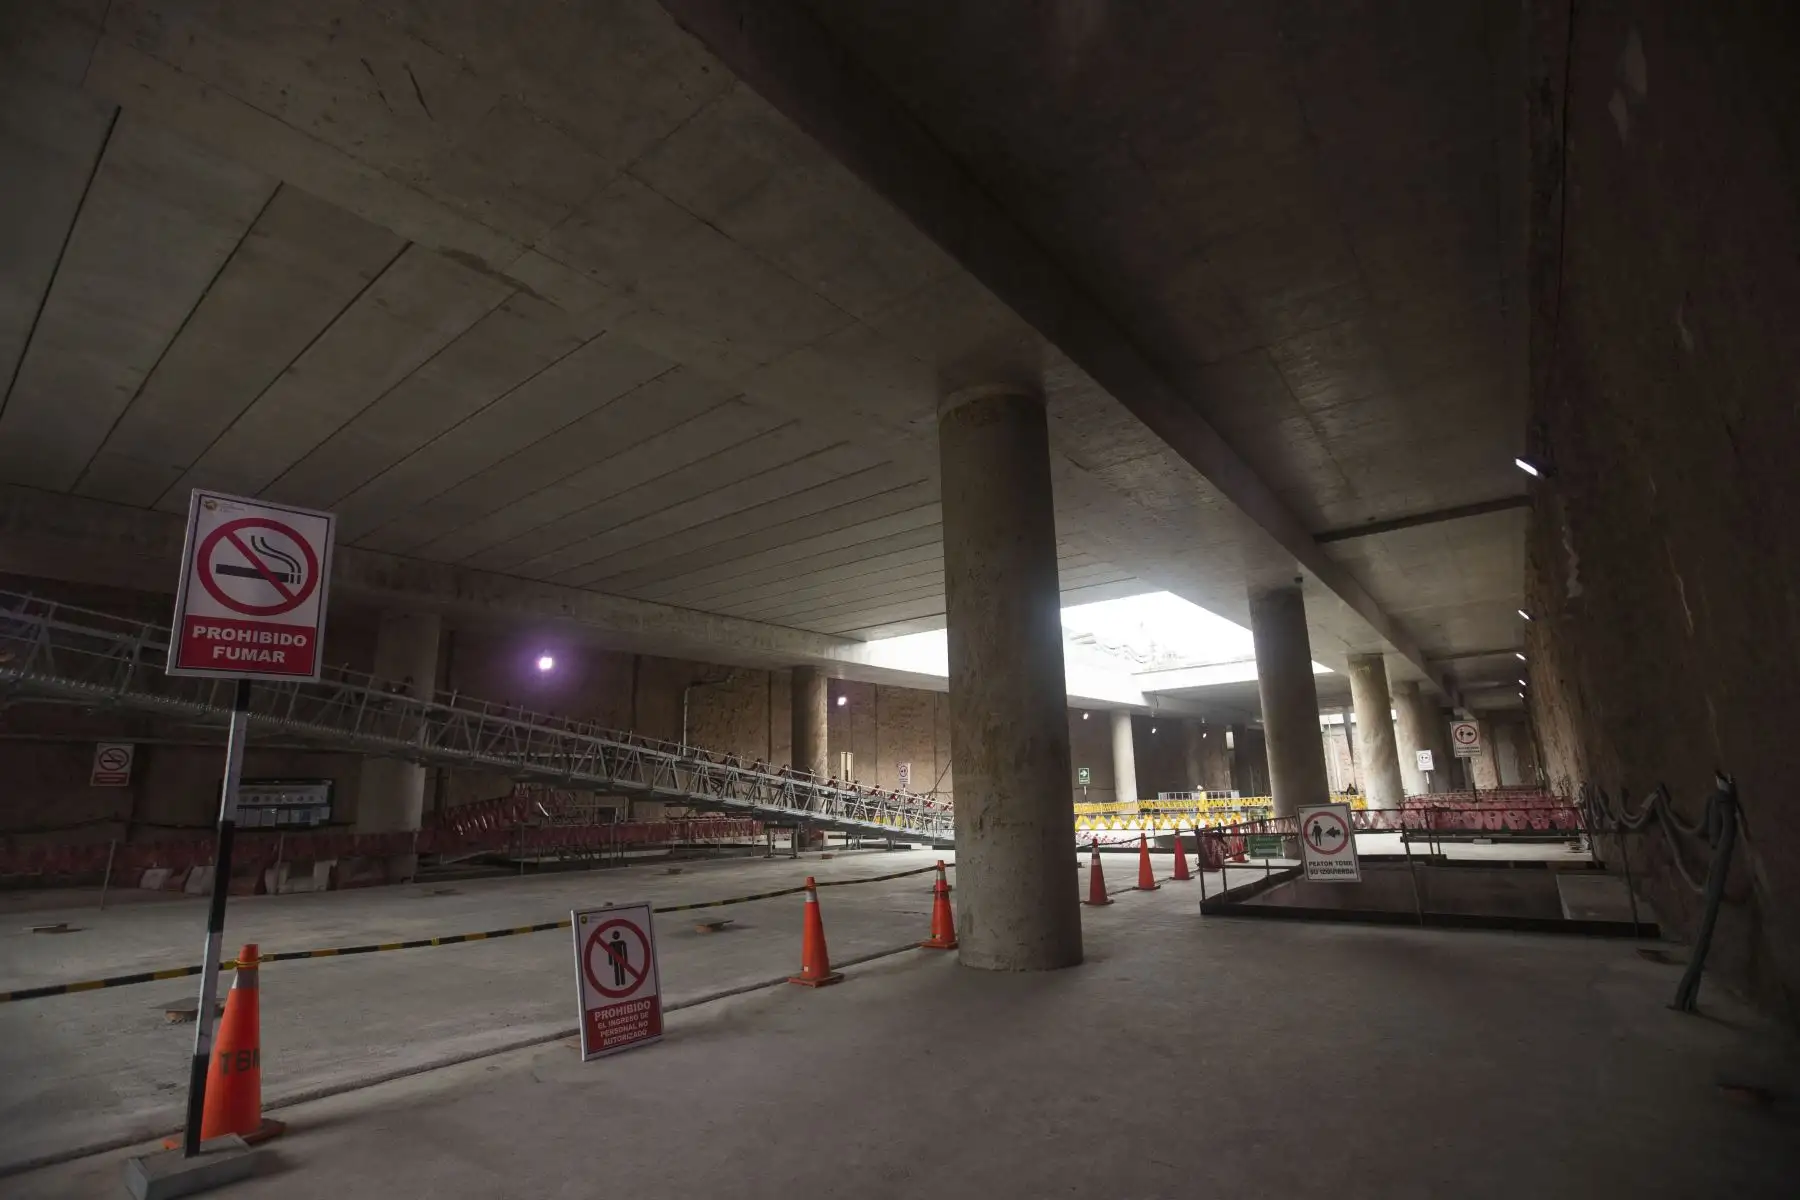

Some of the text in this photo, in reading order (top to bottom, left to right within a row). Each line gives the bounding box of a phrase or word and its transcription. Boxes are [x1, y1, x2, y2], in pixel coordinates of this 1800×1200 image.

[192, 625, 307, 647] PROHIBIDO
[212, 646, 286, 664] FUMAR
[594, 1000, 651, 1022] PROHIBIDO
[597, 1011, 649, 1029] EL INGRESO DE
[600, 1020, 648, 1038] PERSONAL NO
[603, 1029, 648, 1046] AUTORIZADO
